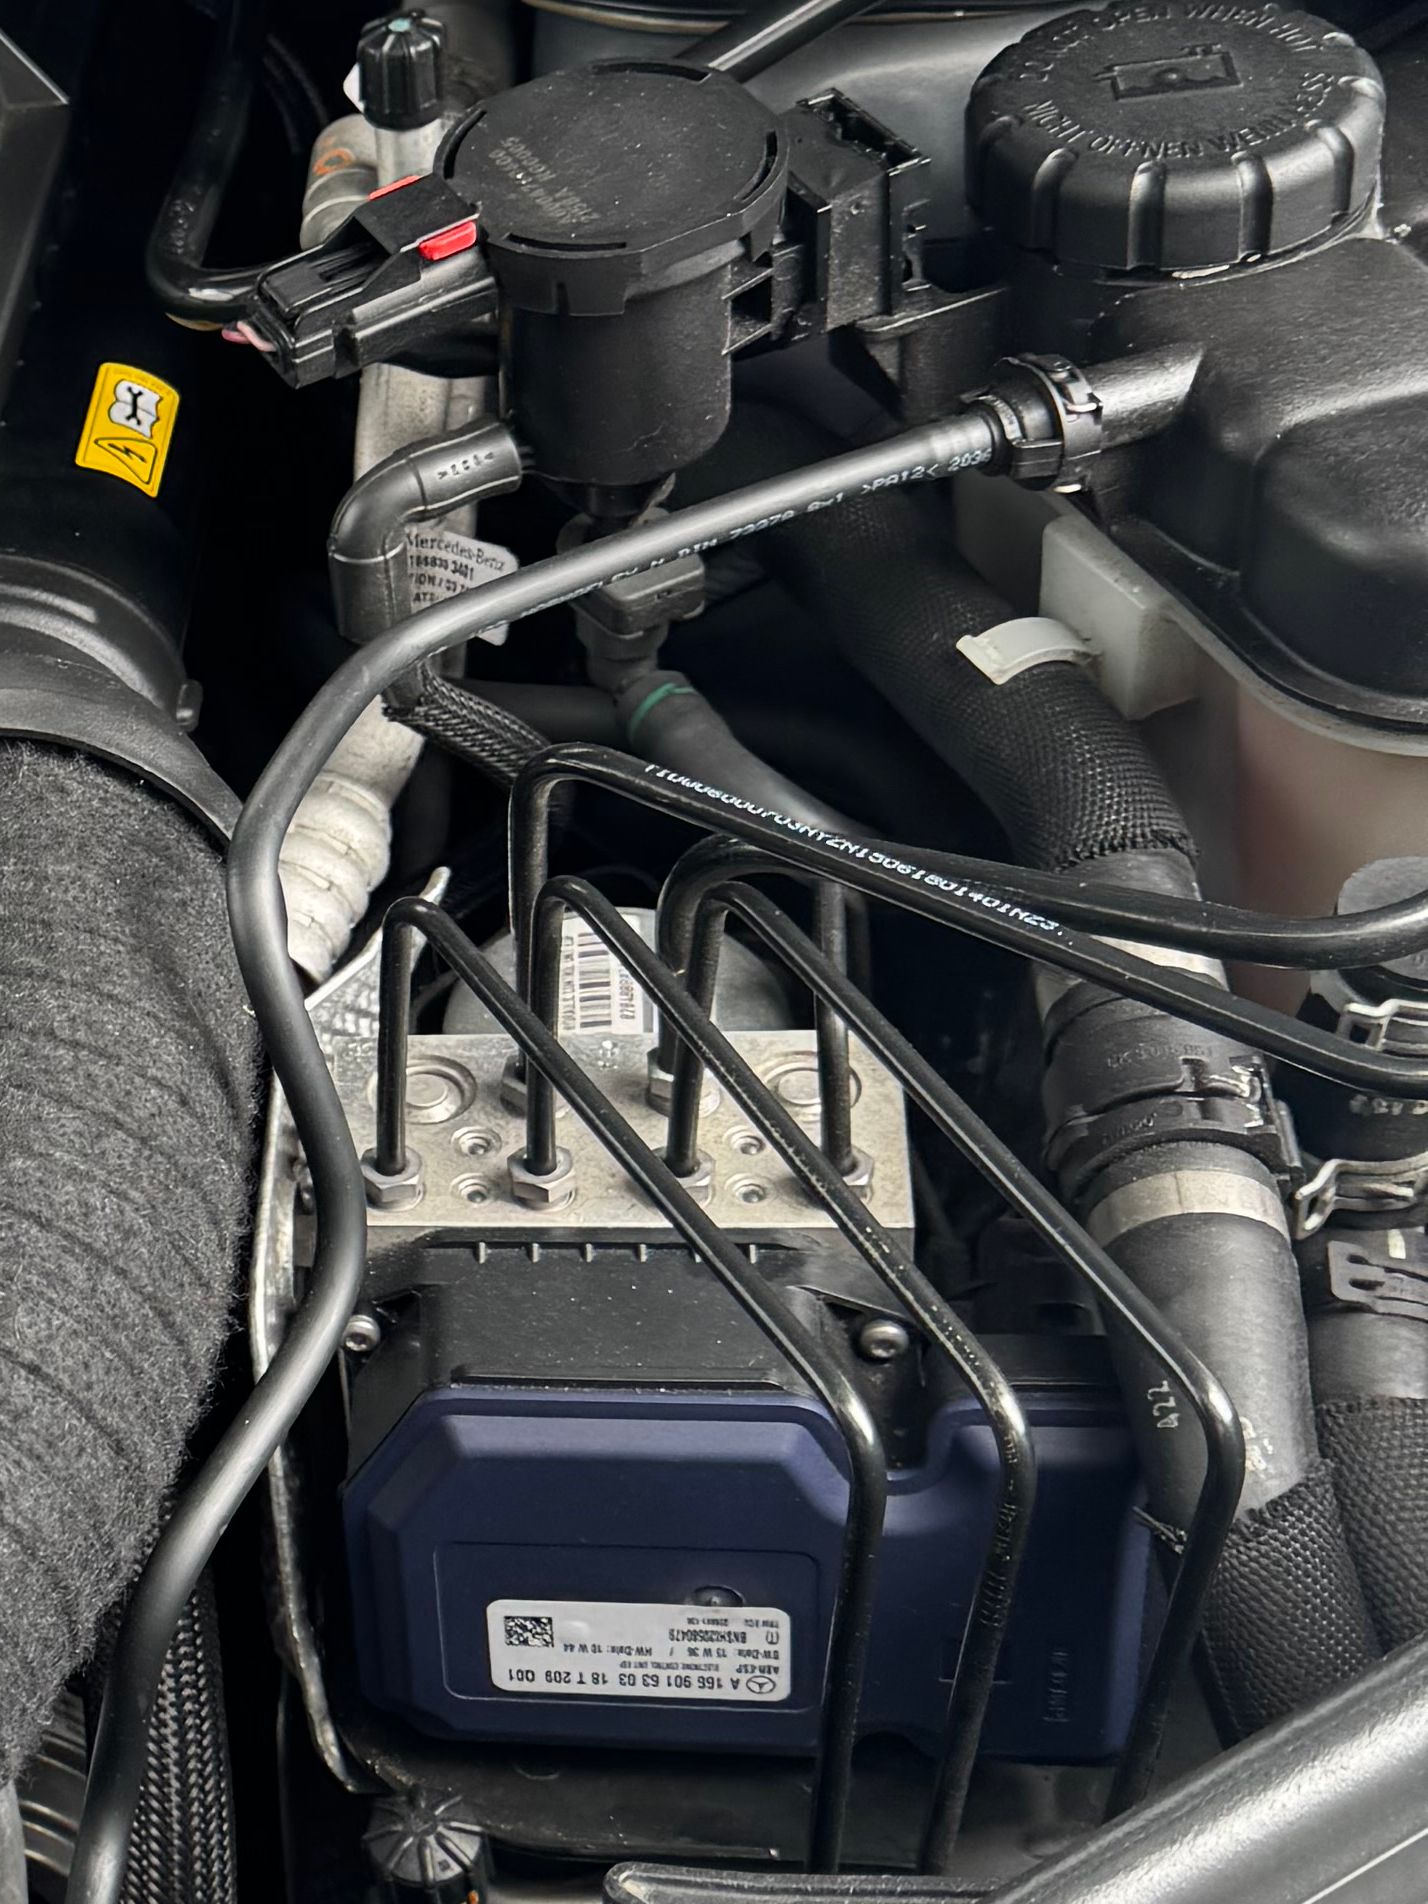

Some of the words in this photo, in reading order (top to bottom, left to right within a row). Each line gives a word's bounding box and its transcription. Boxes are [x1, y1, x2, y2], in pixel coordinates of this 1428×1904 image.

[592, 1672, 608, 1686] 18
[642, 1674, 660, 1687] 63
[666, 1675, 692, 1688] 901
[699, 1676, 723, 1690] 166
[730, 1679, 741, 1690] A
